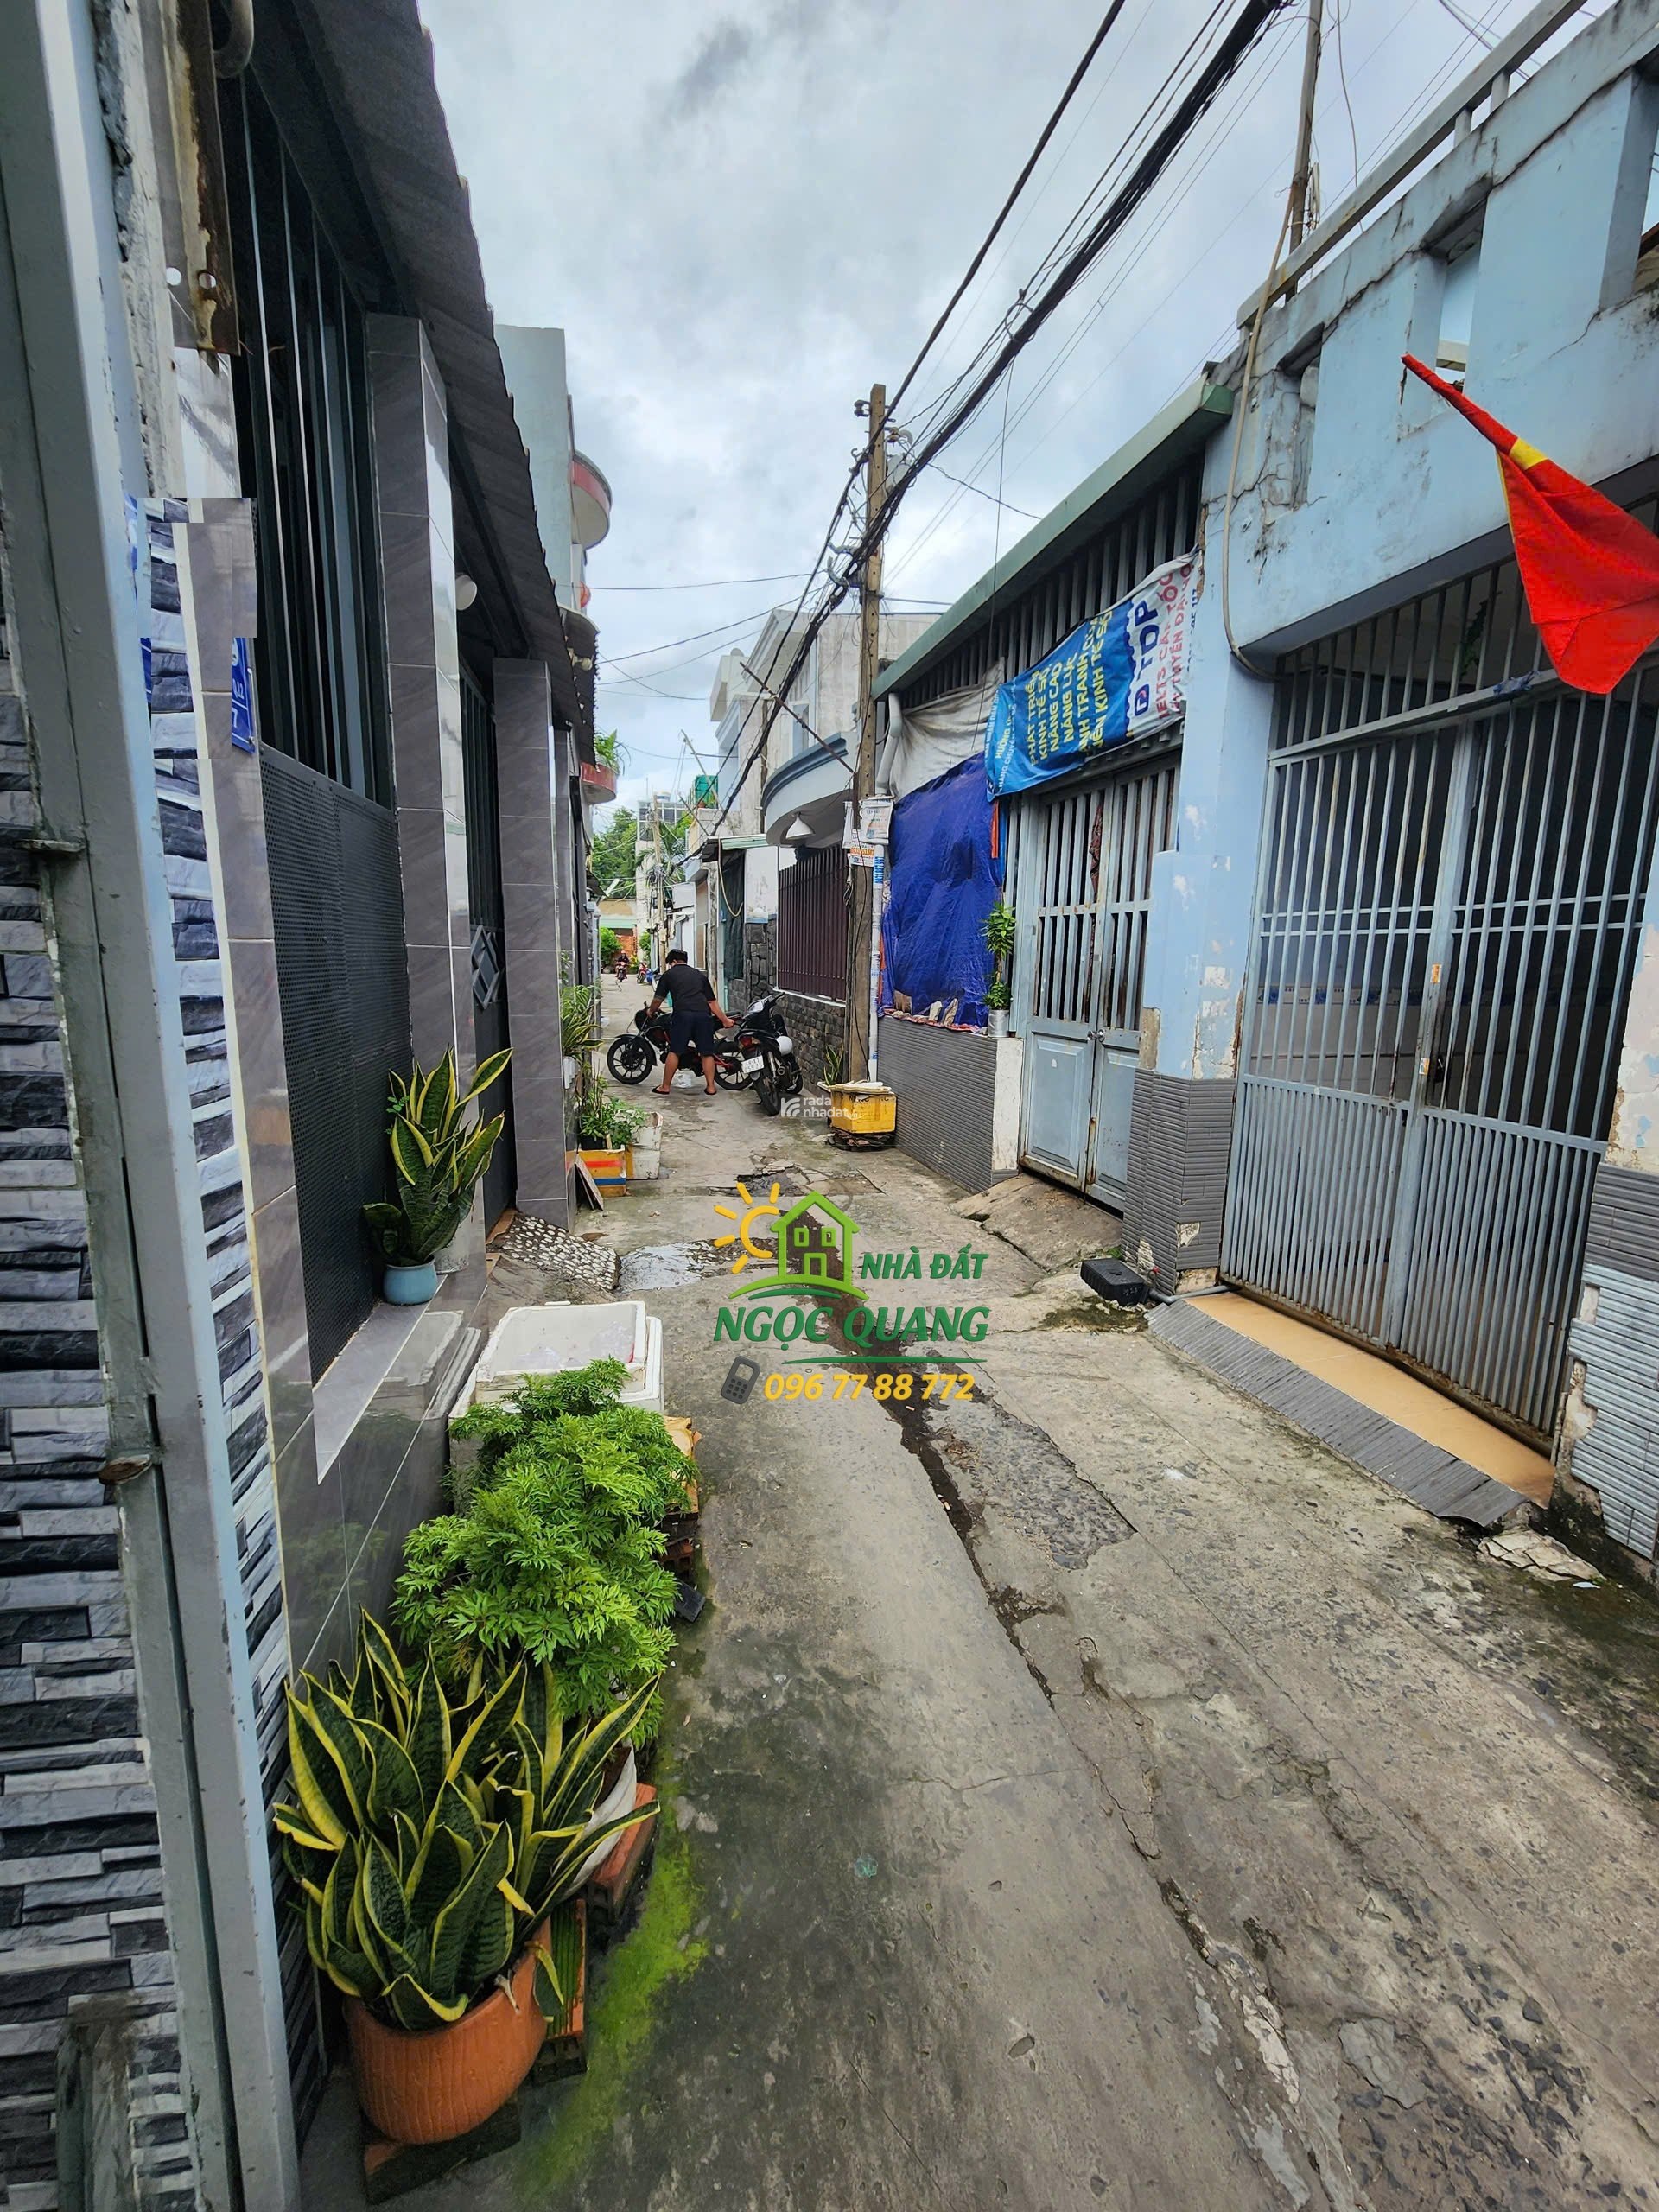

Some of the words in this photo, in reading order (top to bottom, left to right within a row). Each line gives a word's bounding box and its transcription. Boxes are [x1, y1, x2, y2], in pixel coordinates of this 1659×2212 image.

[1134, 600, 1160, 681] TDP
[1049, 662, 1063, 699] CAO
[1077, 652, 1089, 718] TRANH
[1092, 666, 1109, 713] KINH
[1039, 719, 1048, 760] KINH
[1048, 701, 1059, 752] NÂNG
[1061, 690, 1074, 743] NĂNG
